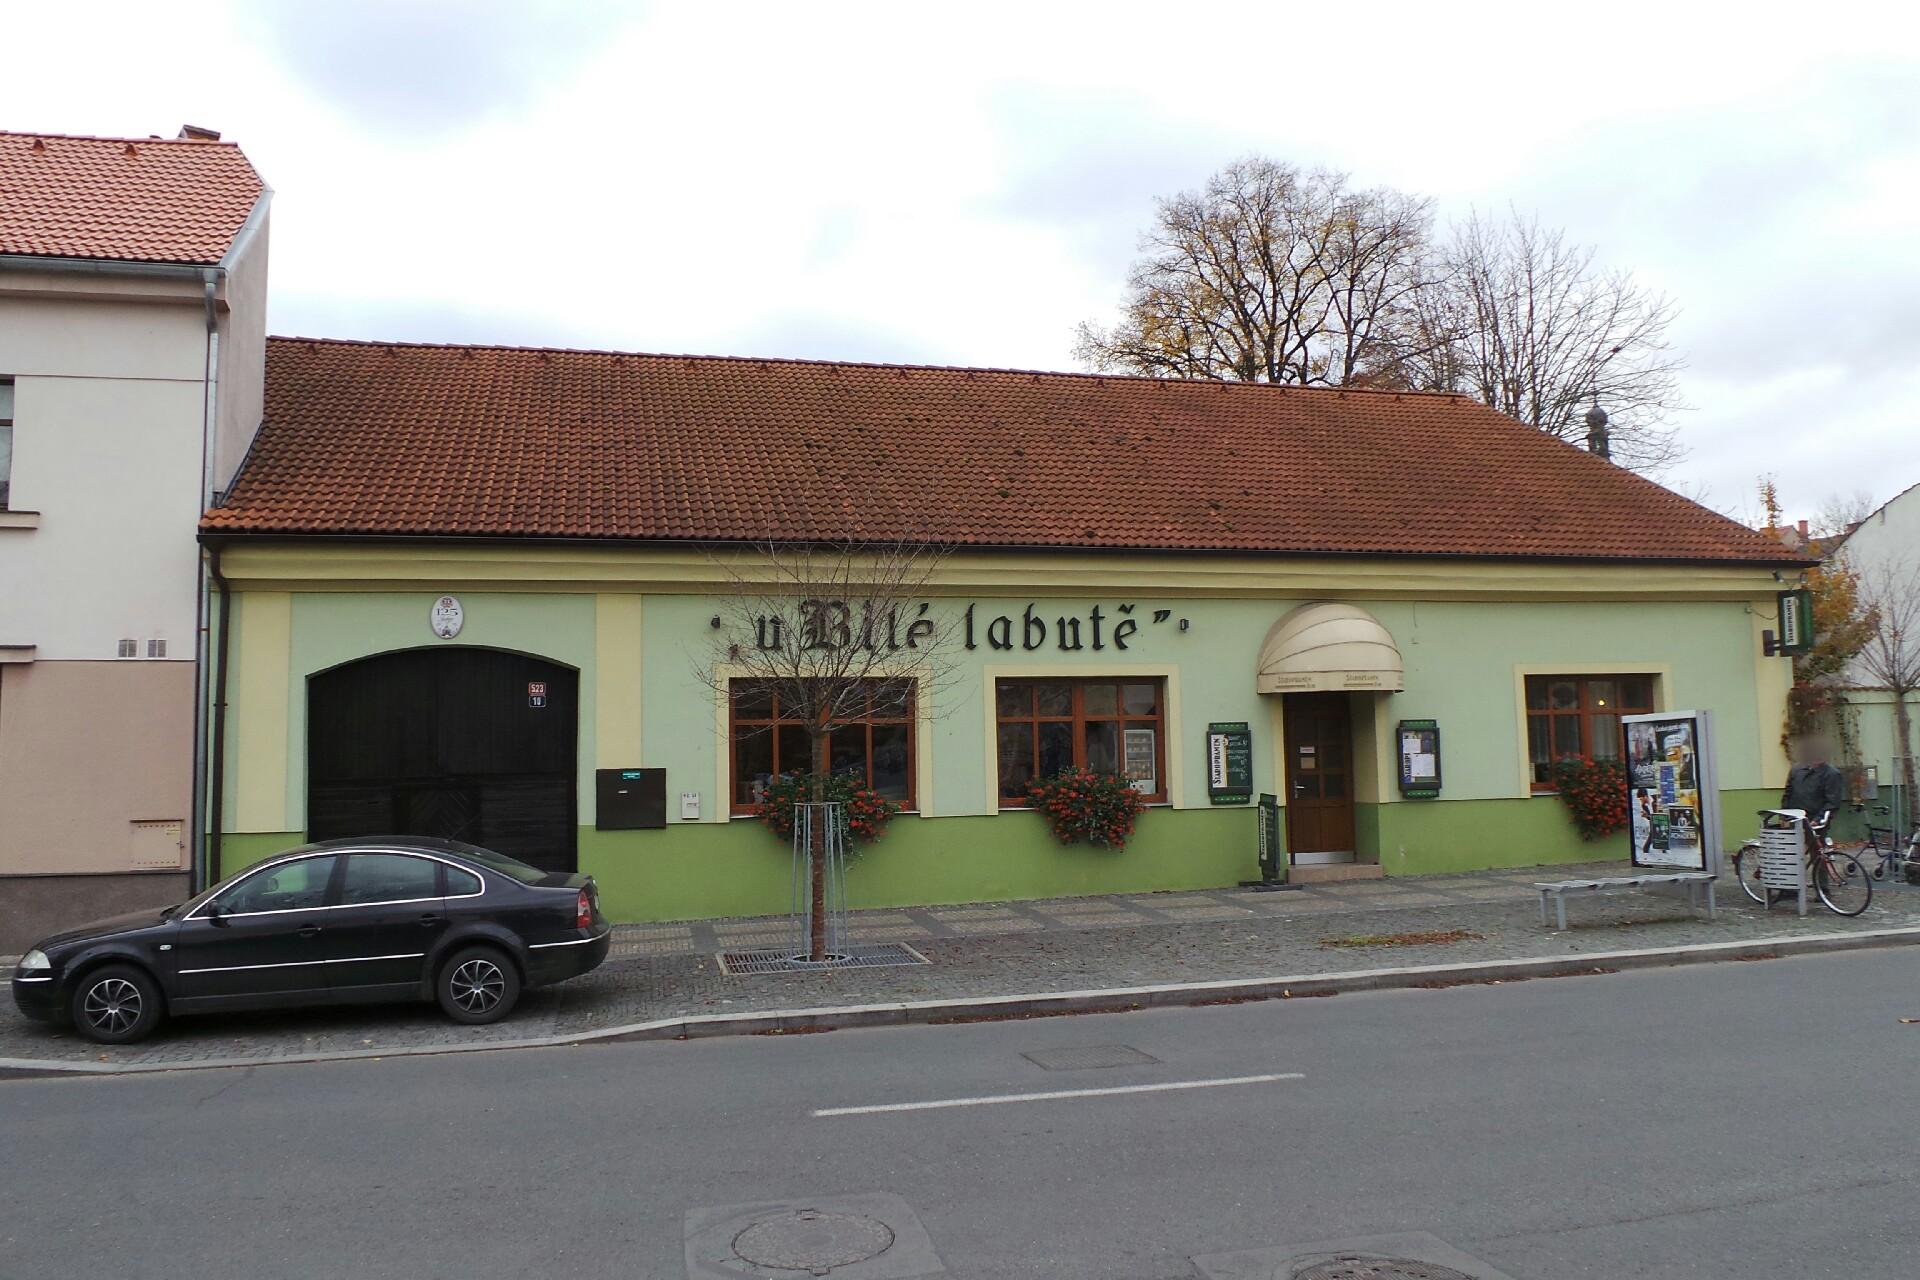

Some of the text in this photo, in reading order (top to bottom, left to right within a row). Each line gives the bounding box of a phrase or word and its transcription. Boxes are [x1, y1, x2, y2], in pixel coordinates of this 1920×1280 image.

[531, 684, 544, 693] 523
[532, 696, 541, 706] 10
[1213, 738, 1222, 785] STAROPRAMEN
